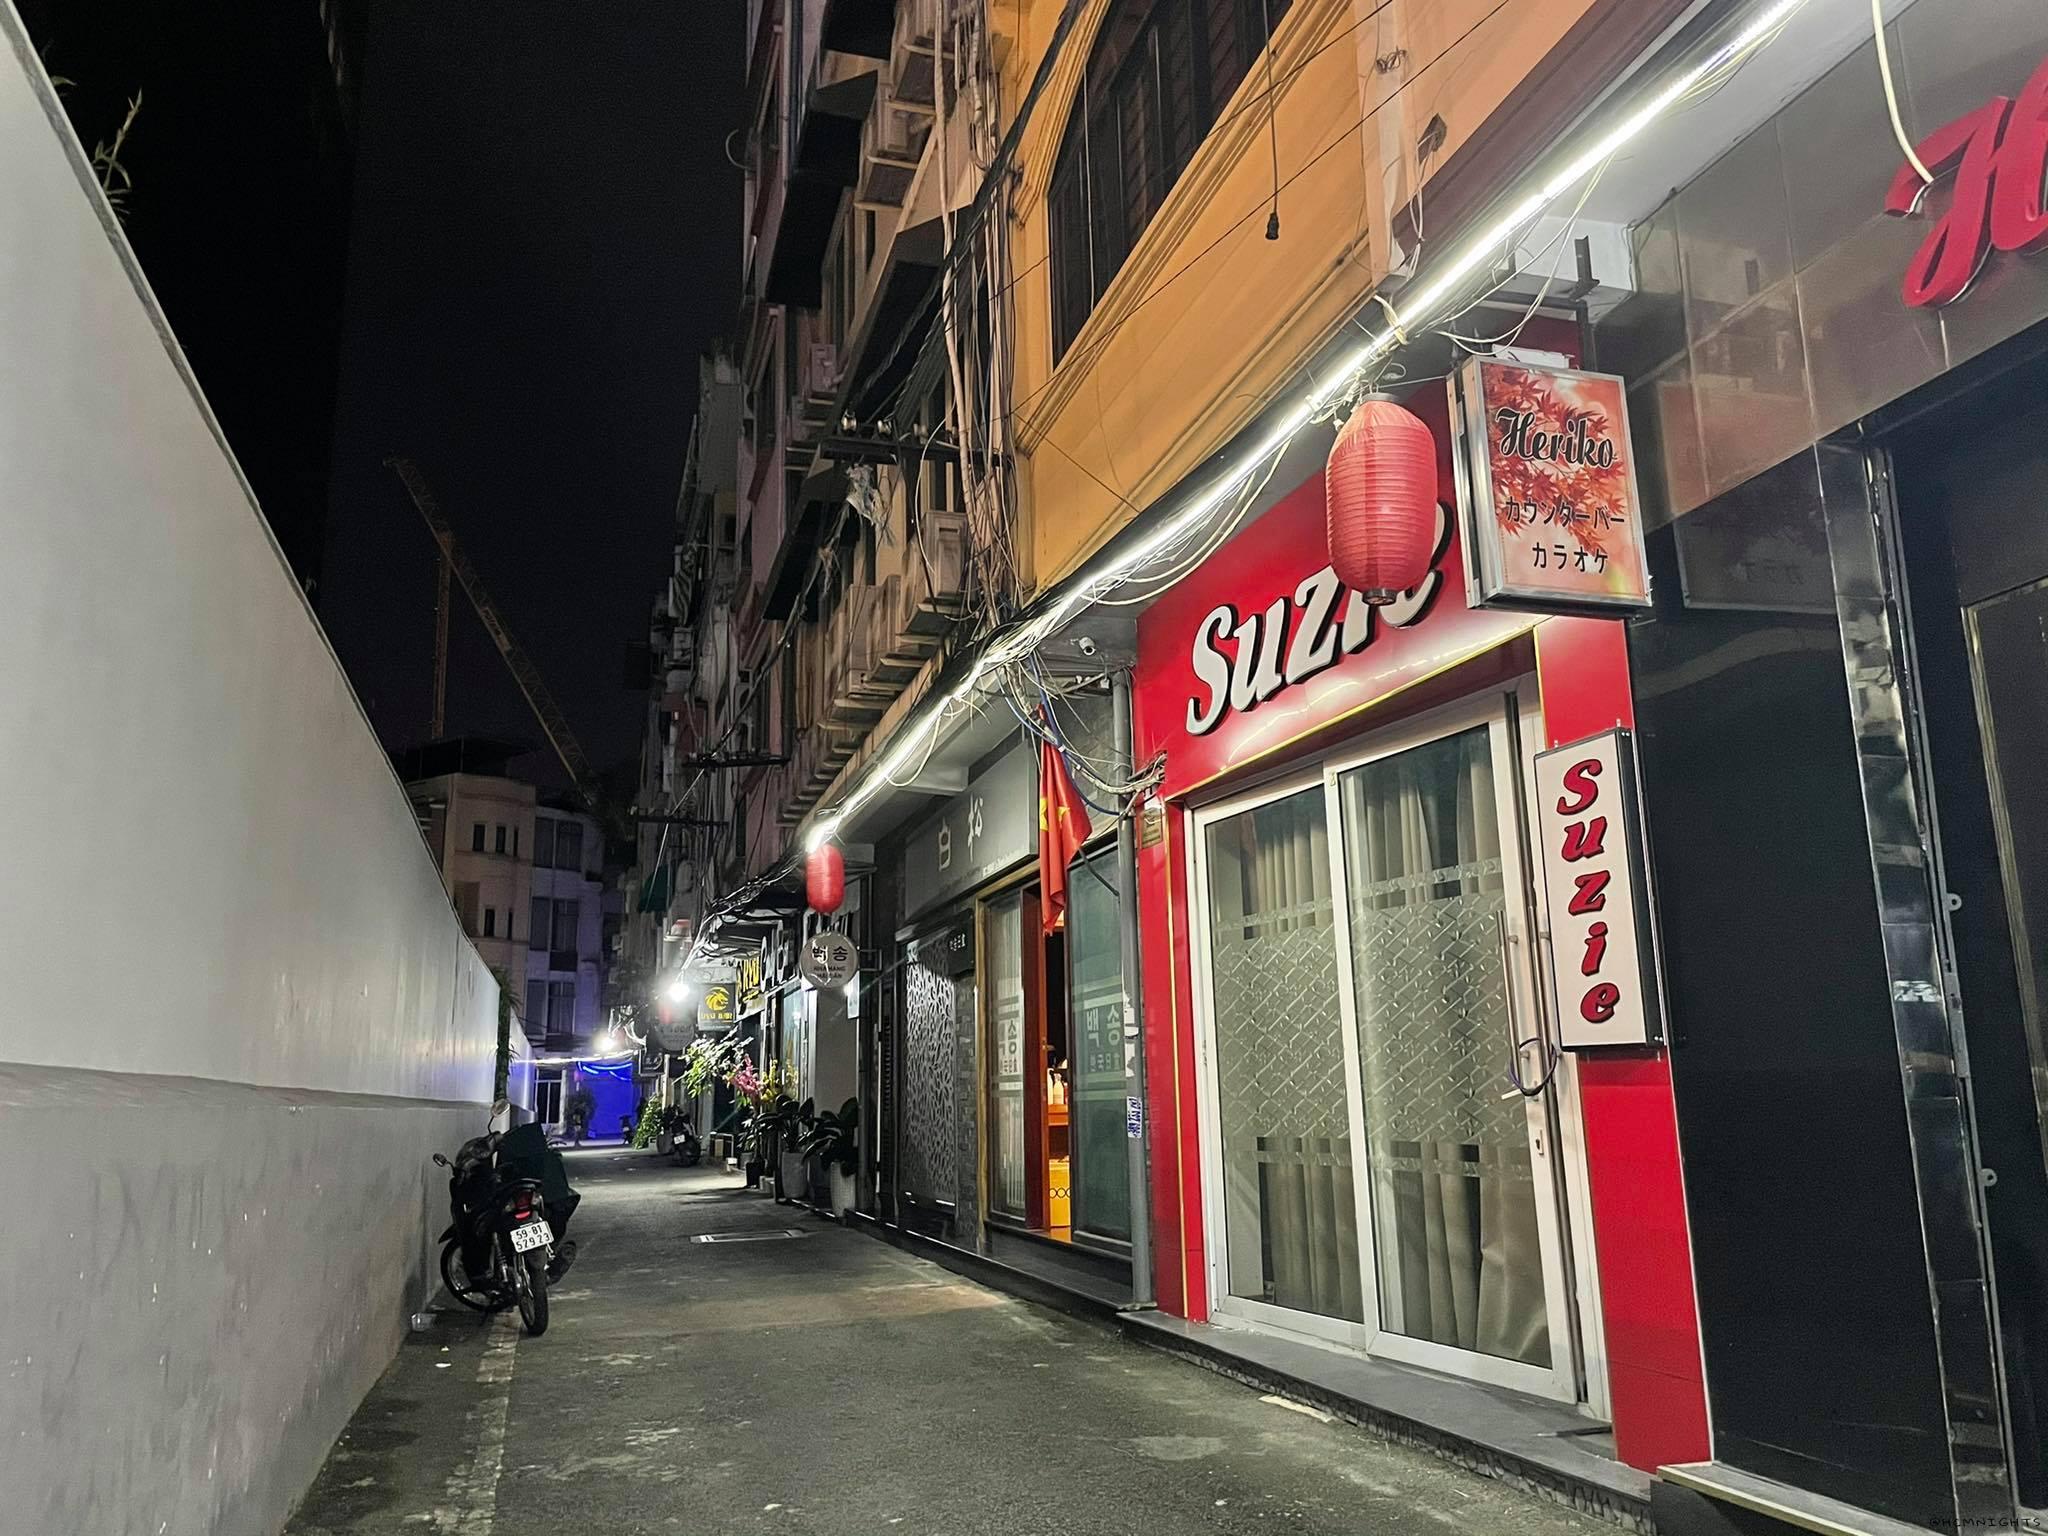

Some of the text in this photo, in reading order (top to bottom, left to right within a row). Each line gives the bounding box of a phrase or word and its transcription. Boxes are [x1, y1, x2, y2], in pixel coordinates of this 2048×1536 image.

[1496, 408, 1617, 469] Heriko
[1505, 496, 1625, 531] カウンターバー
[1532, 541, 1609, 574] カラオケ
[1556, 758, 1621, 1024] Suzie
[1086, 1004, 1122, 1048] 백송
